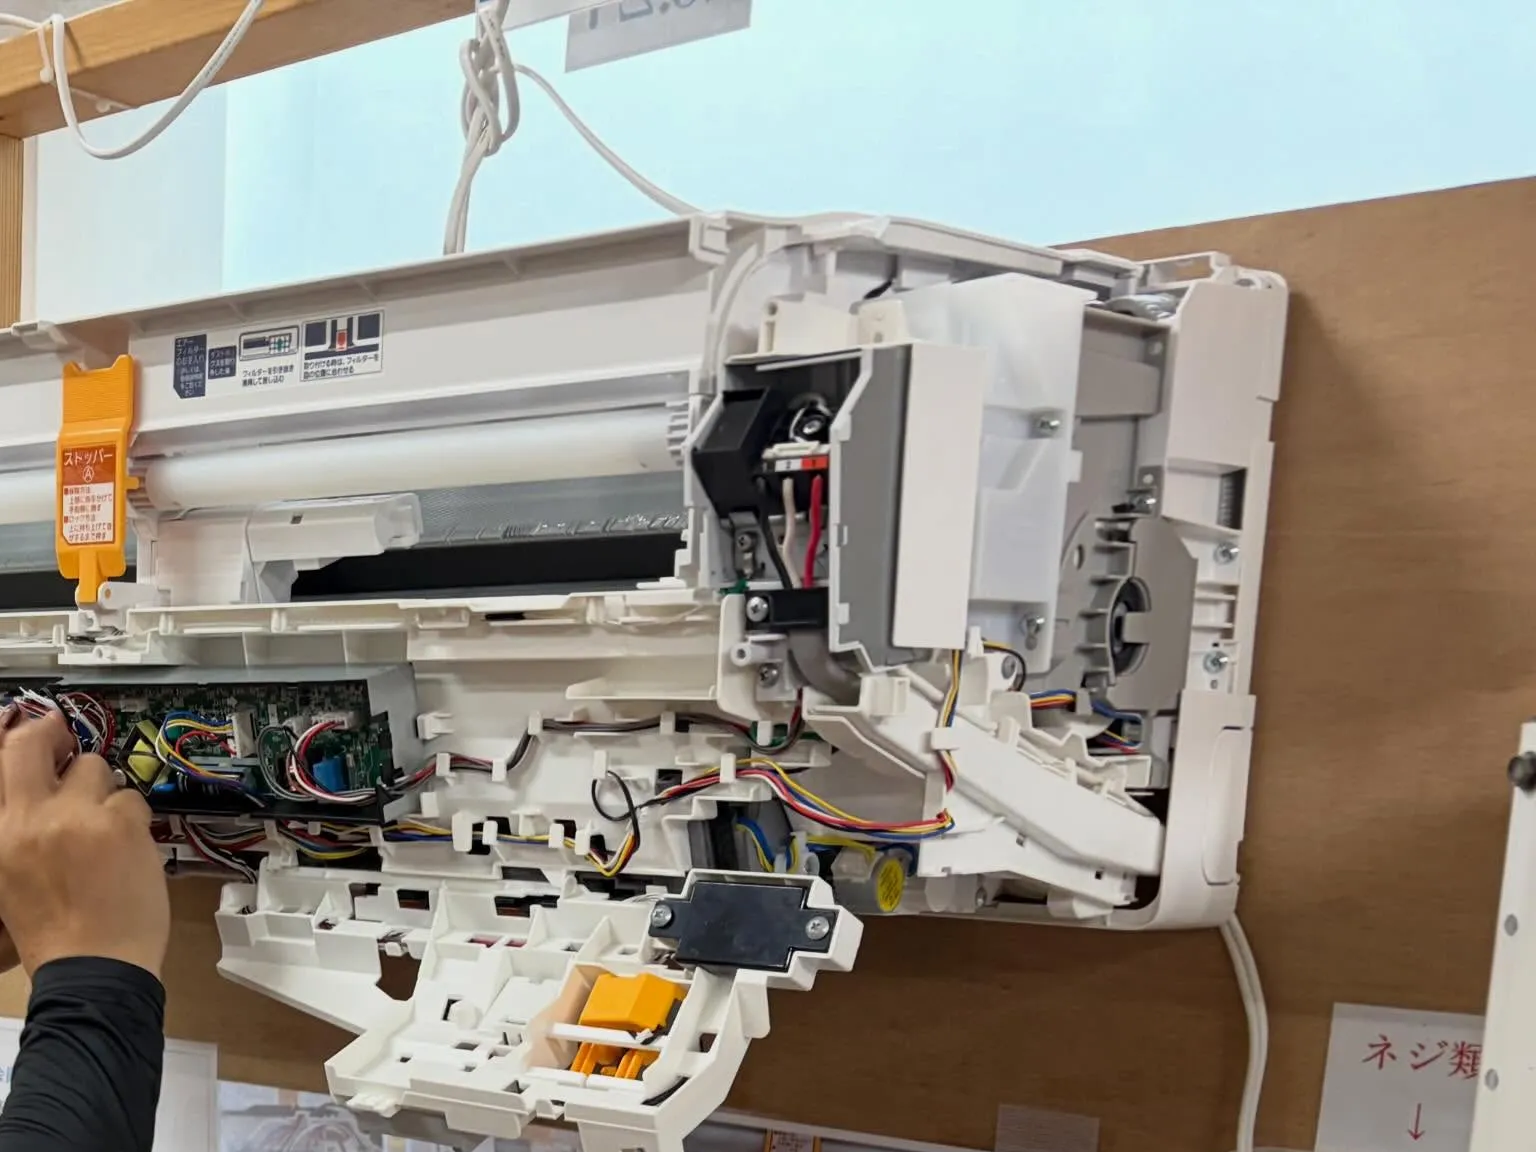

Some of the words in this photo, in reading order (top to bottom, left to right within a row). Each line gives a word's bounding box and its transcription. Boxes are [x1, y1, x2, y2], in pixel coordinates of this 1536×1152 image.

[64, 447, 113, 466] ストッパー
[1361, 1033, 1483, 1080] ネジ類
